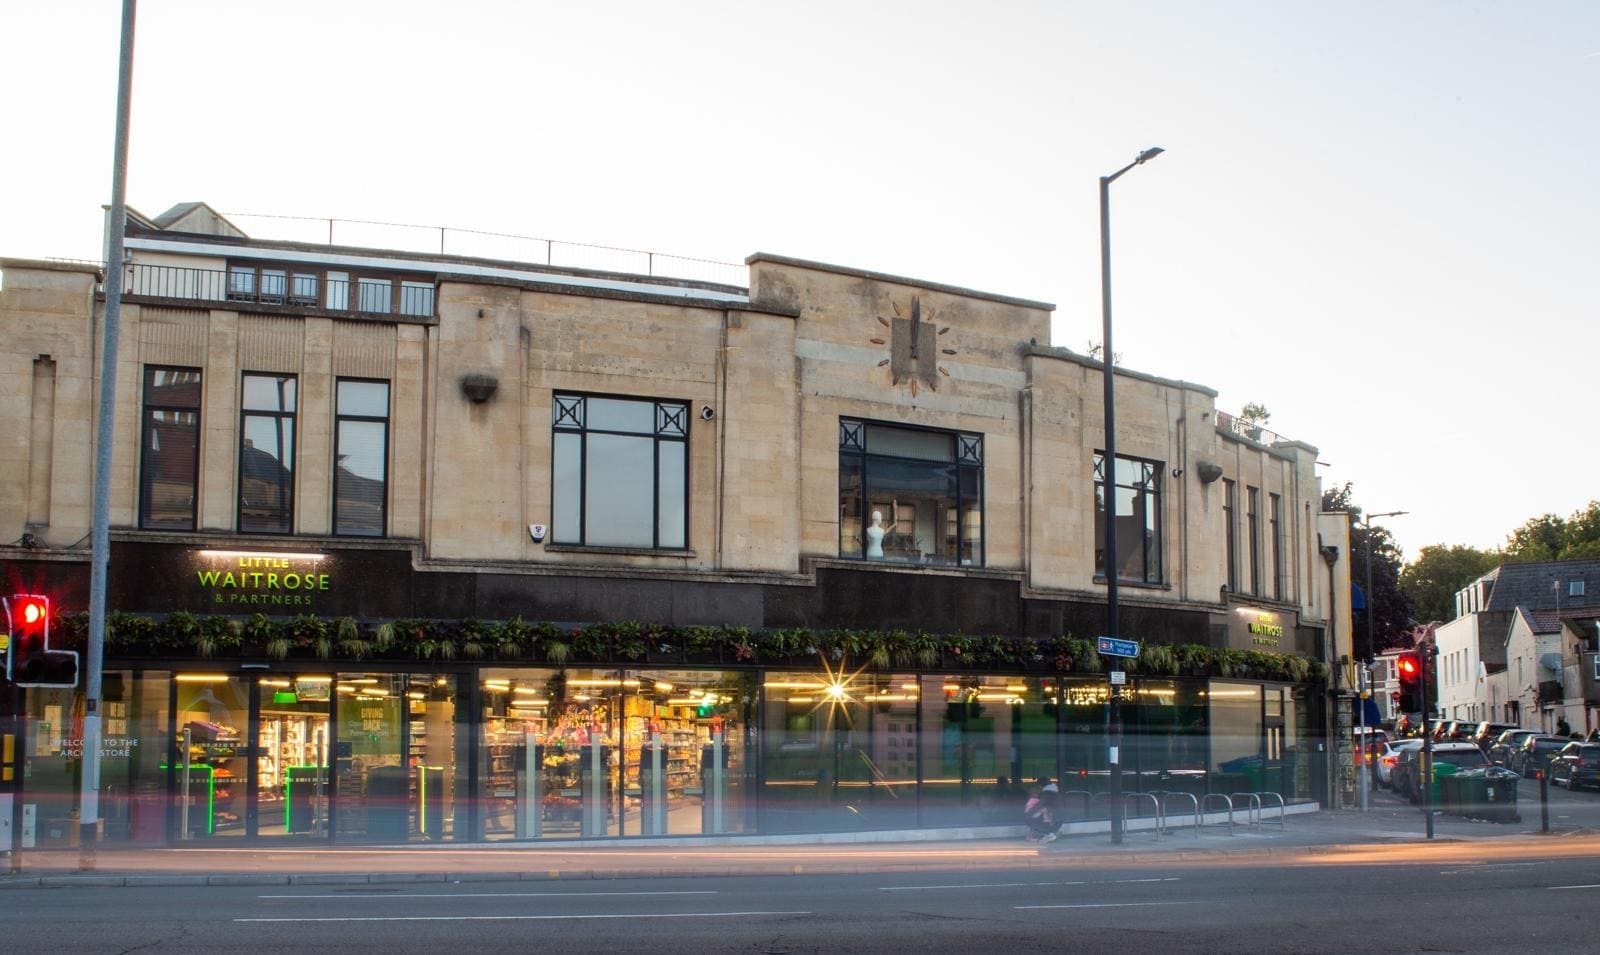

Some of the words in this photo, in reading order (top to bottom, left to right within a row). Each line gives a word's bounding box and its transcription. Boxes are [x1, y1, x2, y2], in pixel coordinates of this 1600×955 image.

[239, 557, 289, 568] LITTLE
[197, 571, 330, 590] WAITROSE
[215, 593, 223, 603] &
[230, 593, 312, 605] PARTNERS
[1250, 623, 1283, 637] WAITROSE
[121, 739, 139, 747] THE
[100, 749, 130, 757] STORE
